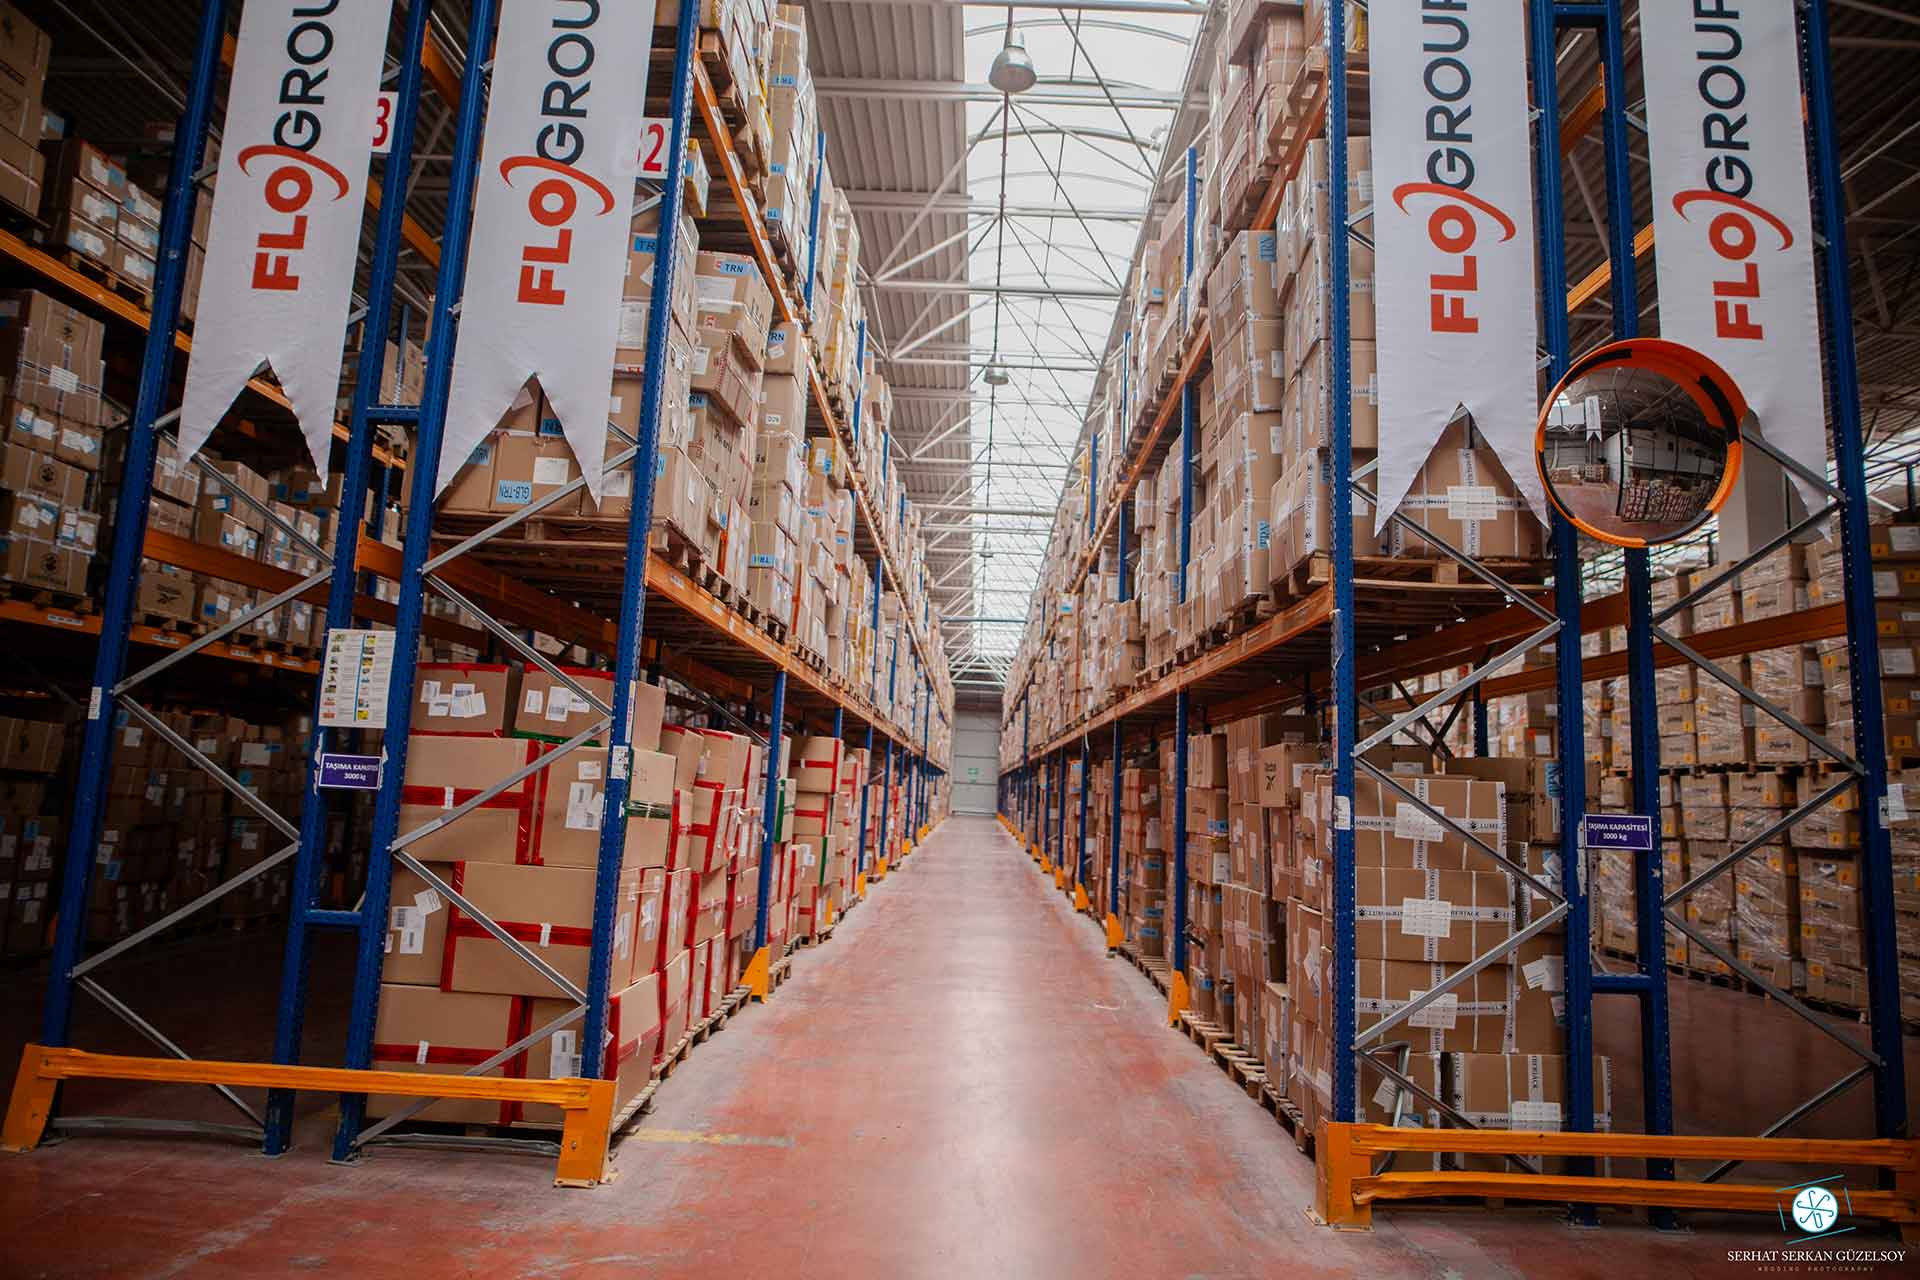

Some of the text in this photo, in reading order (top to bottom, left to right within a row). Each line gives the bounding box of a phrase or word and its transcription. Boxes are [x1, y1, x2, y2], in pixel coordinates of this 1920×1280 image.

[251, 165, 314, 291] FLO
[517, 178, 577, 306] FLO
[725, 264, 744, 273] TRN
[1428, 204, 1479, 333] FLO
[1708, 211, 1764, 340] FLO
